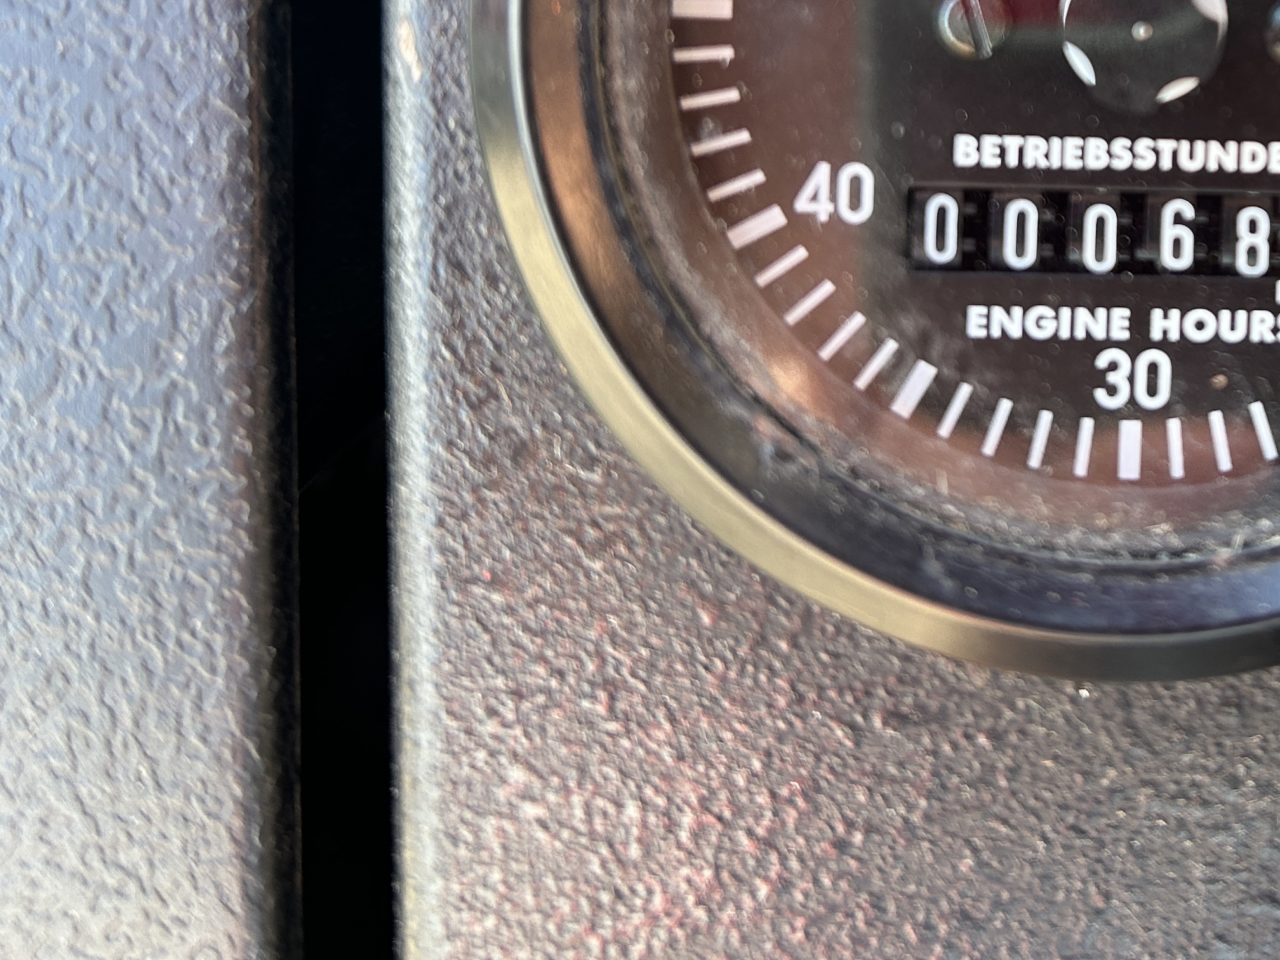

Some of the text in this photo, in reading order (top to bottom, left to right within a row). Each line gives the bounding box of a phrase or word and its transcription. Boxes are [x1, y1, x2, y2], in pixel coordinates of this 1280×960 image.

[793, 160, 875, 225] 40
[965, 304, 1131, 340] ENGINE
[1093, 347, 1173, 410] 30
